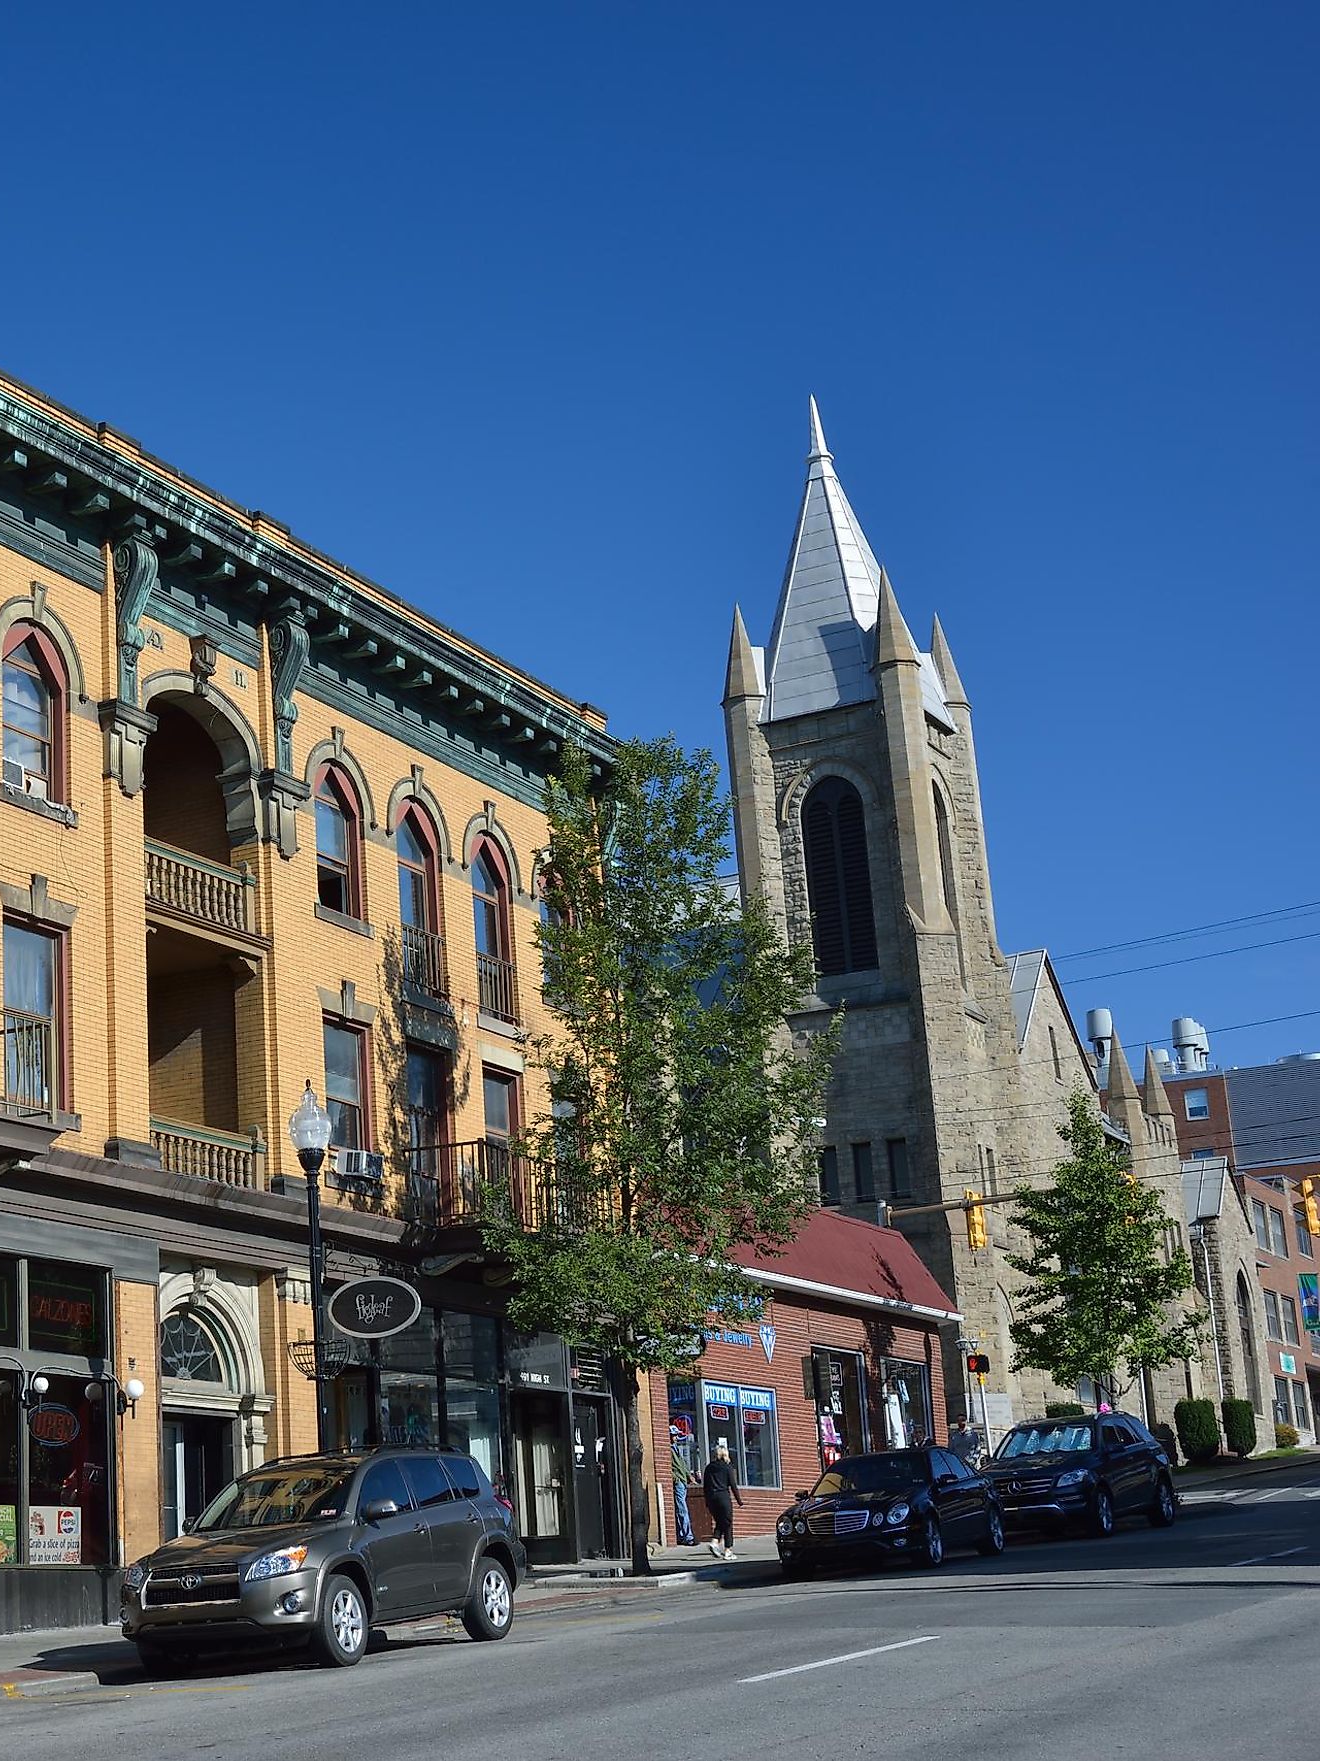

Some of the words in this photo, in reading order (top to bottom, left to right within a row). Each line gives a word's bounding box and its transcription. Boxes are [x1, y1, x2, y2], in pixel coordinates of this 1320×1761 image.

[704, 1386, 736, 1403] BUYING
[740, 1390, 770, 1408] BUYING
[60, 1518, 77, 1526] PEPSI
[47, 1538, 59, 1549] slice
[59, 1538, 66, 1548] of
[67, 1538, 80, 1550] pizza
[51, 1552, 62, 1562] cold
